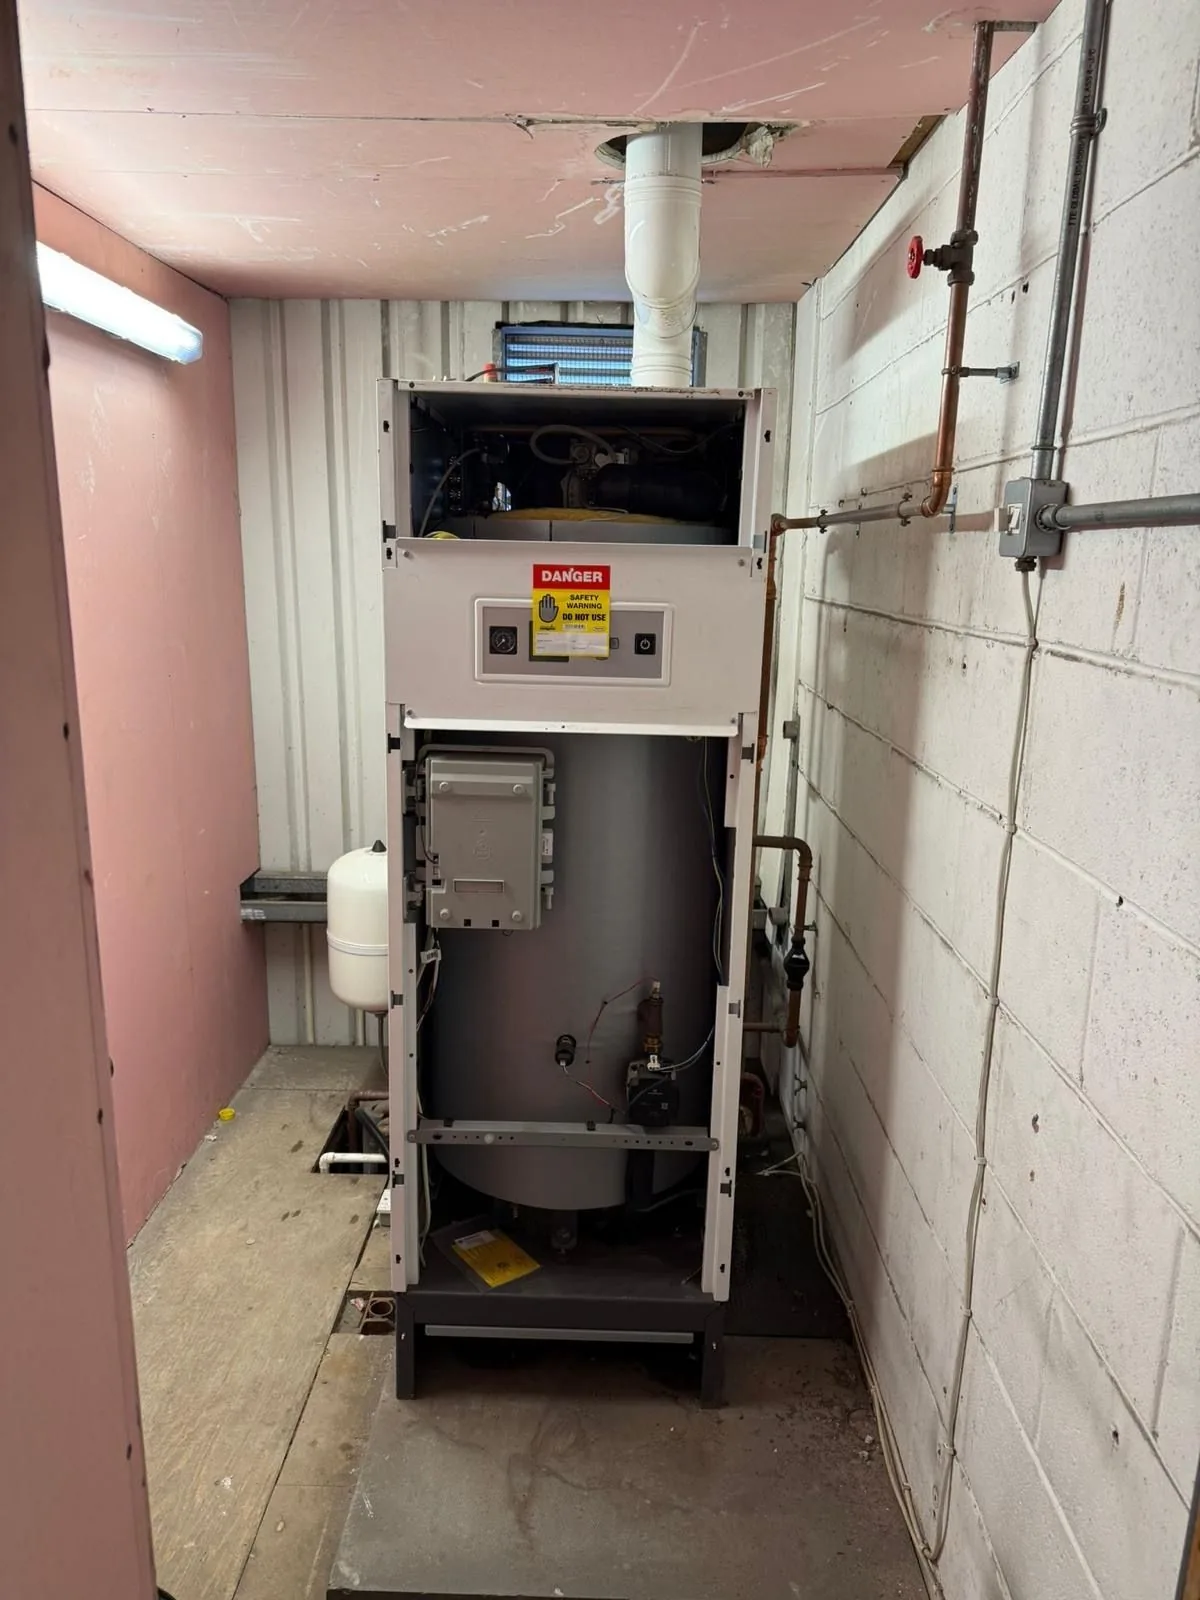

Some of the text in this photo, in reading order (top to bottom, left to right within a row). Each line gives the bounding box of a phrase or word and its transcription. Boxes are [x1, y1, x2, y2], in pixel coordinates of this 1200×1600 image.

[1070, 179, 1081, 209] GLOBAL
[1082, 76, 1093, 104] CLASS
[541, 570, 603, 583] DANGER
[562, 613, 606, 621] DO NOT USE
